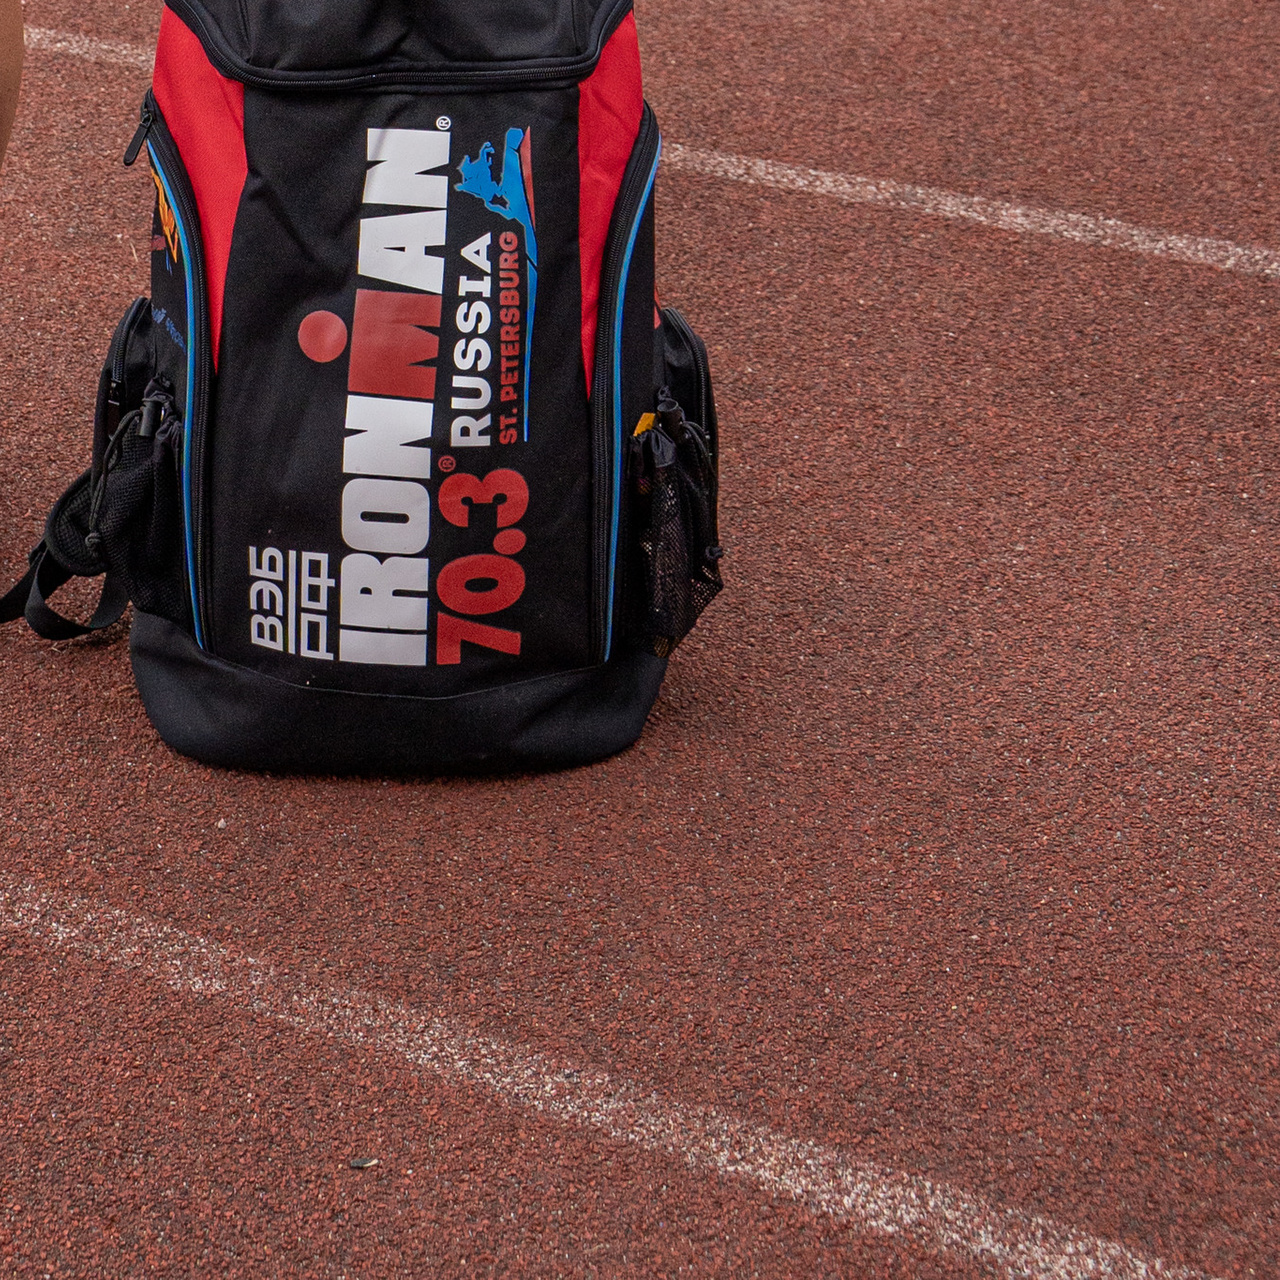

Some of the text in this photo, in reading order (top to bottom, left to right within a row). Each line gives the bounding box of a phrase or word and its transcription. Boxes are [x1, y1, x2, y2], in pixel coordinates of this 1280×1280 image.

[436, 232, 529, 665] 70.3 RUSSIA
[499, 231, 520, 445] ST. PETERSBURG
